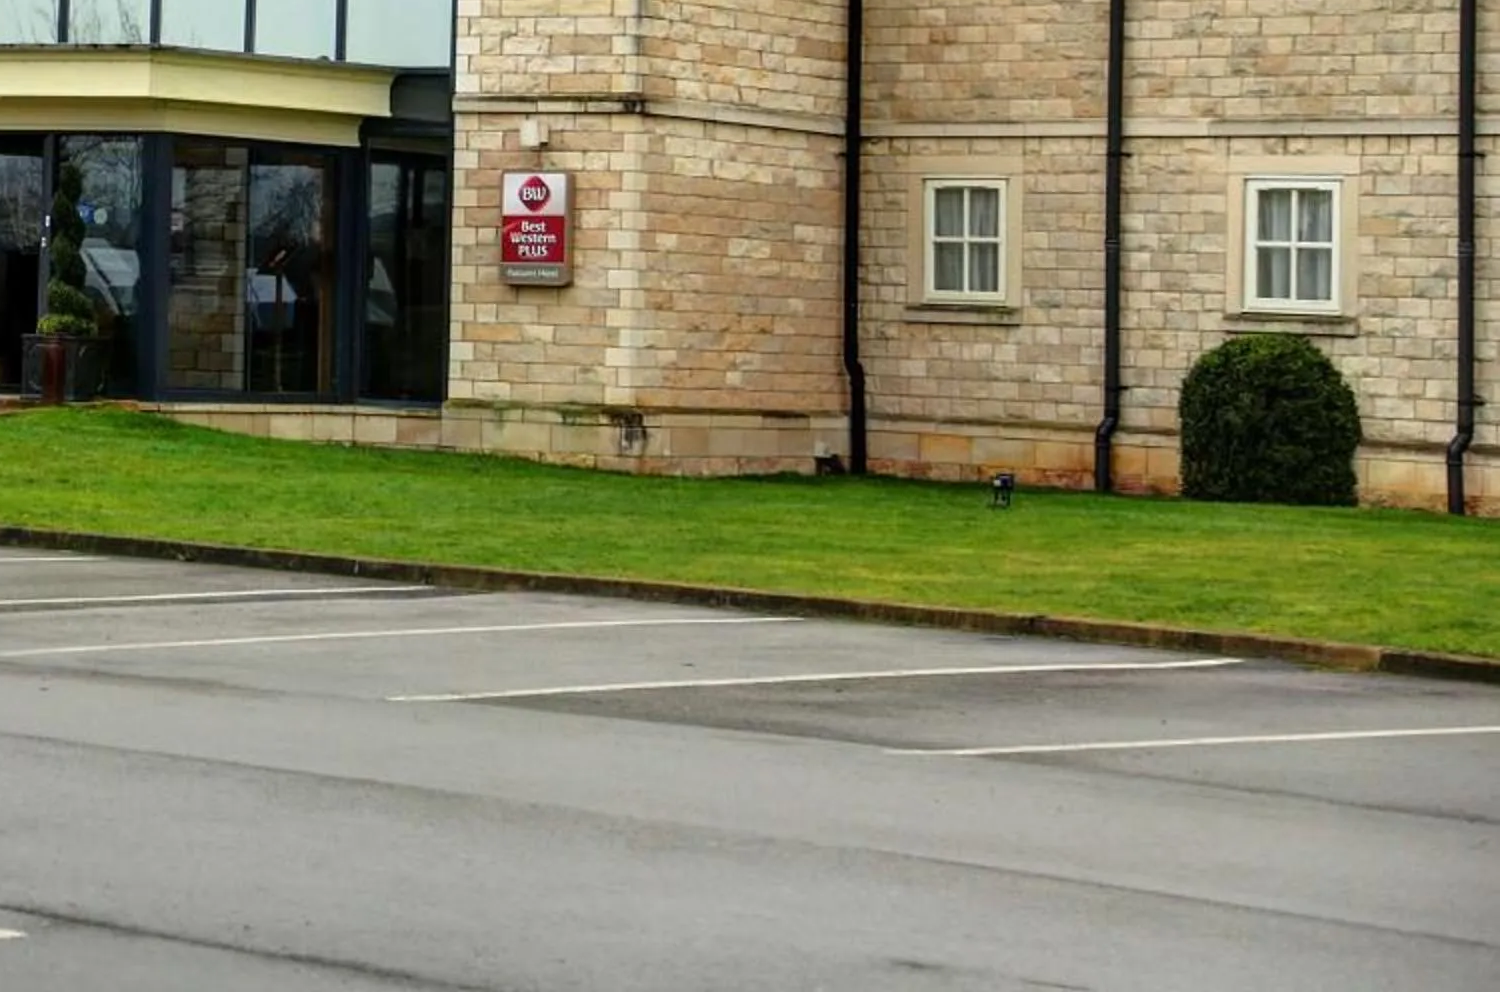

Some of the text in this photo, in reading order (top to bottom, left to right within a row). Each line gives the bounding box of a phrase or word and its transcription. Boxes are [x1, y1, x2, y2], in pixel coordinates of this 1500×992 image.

[523, 186, 547, 201] BW
[521, 221, 546, 232] Best
[510, 232, 557, 243] Western
